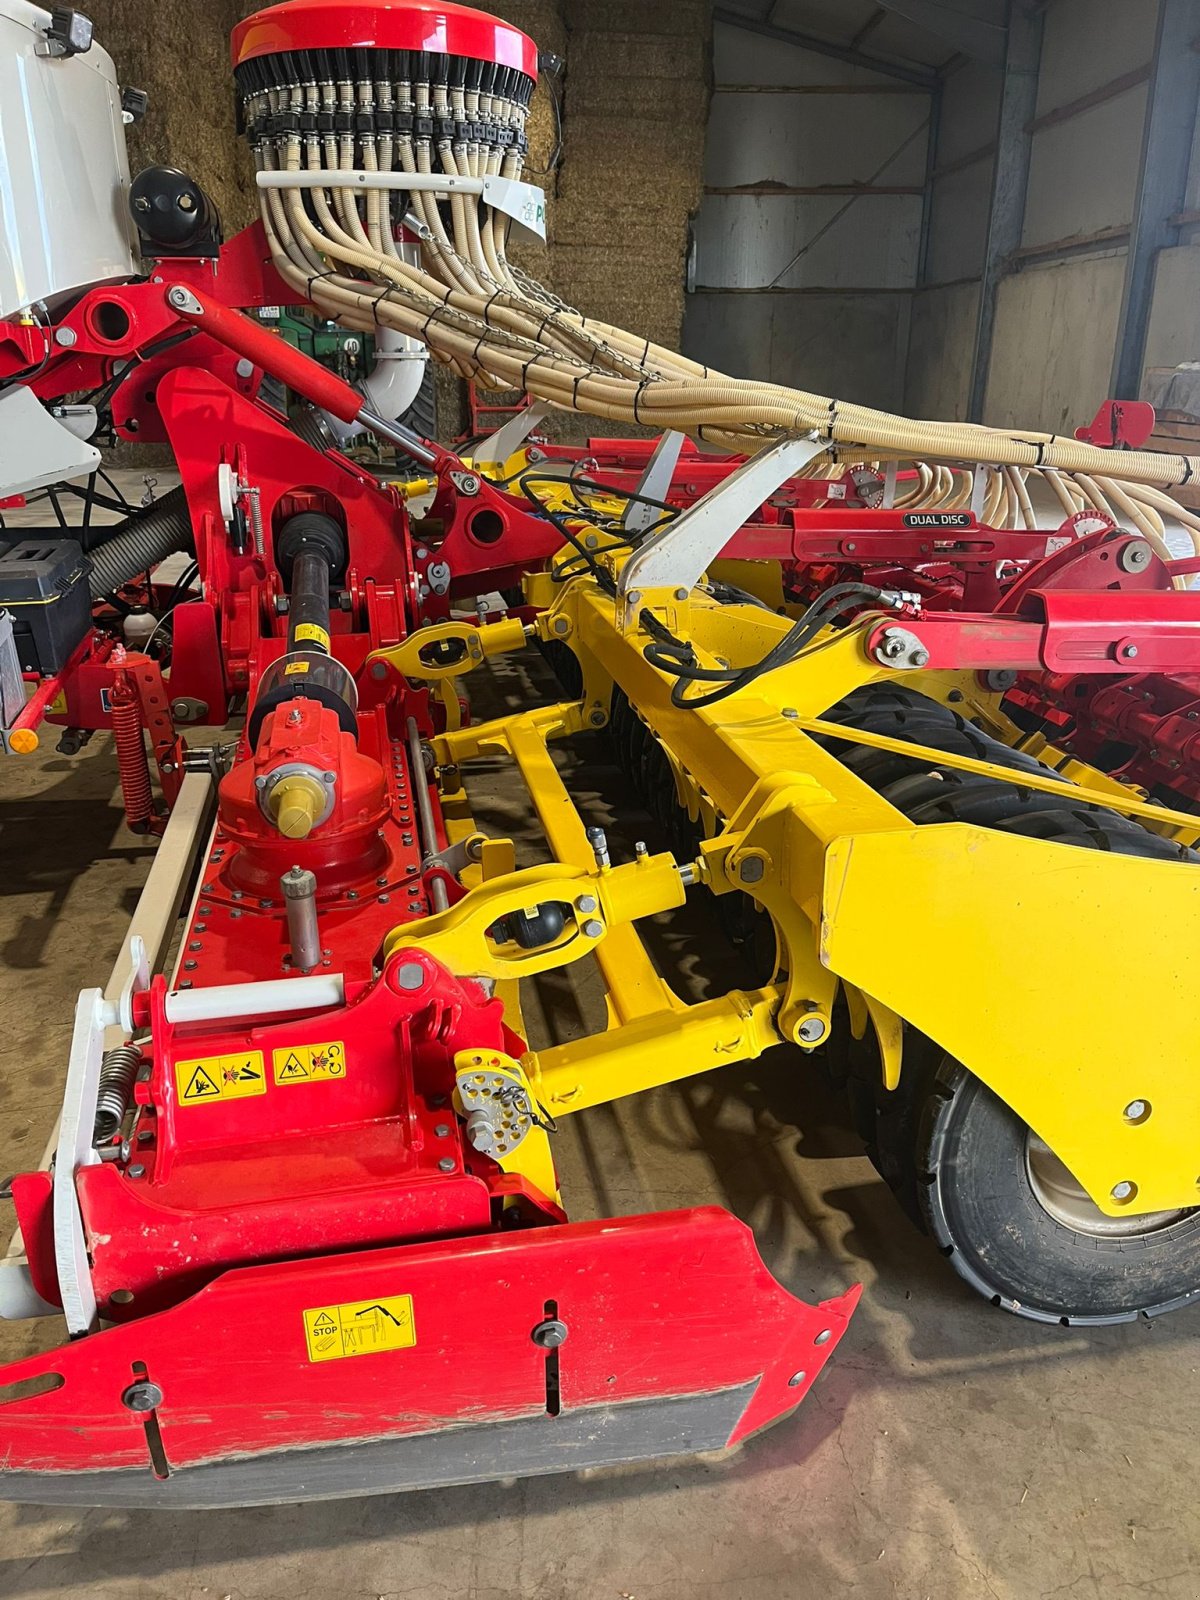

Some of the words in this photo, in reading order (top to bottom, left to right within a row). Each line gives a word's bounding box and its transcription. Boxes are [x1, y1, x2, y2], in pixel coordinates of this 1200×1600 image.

[910, 515, 939, 525] DUAL
[941, 515, 965, 524] DISC
[313, 1326, 338, 1336] STOP
